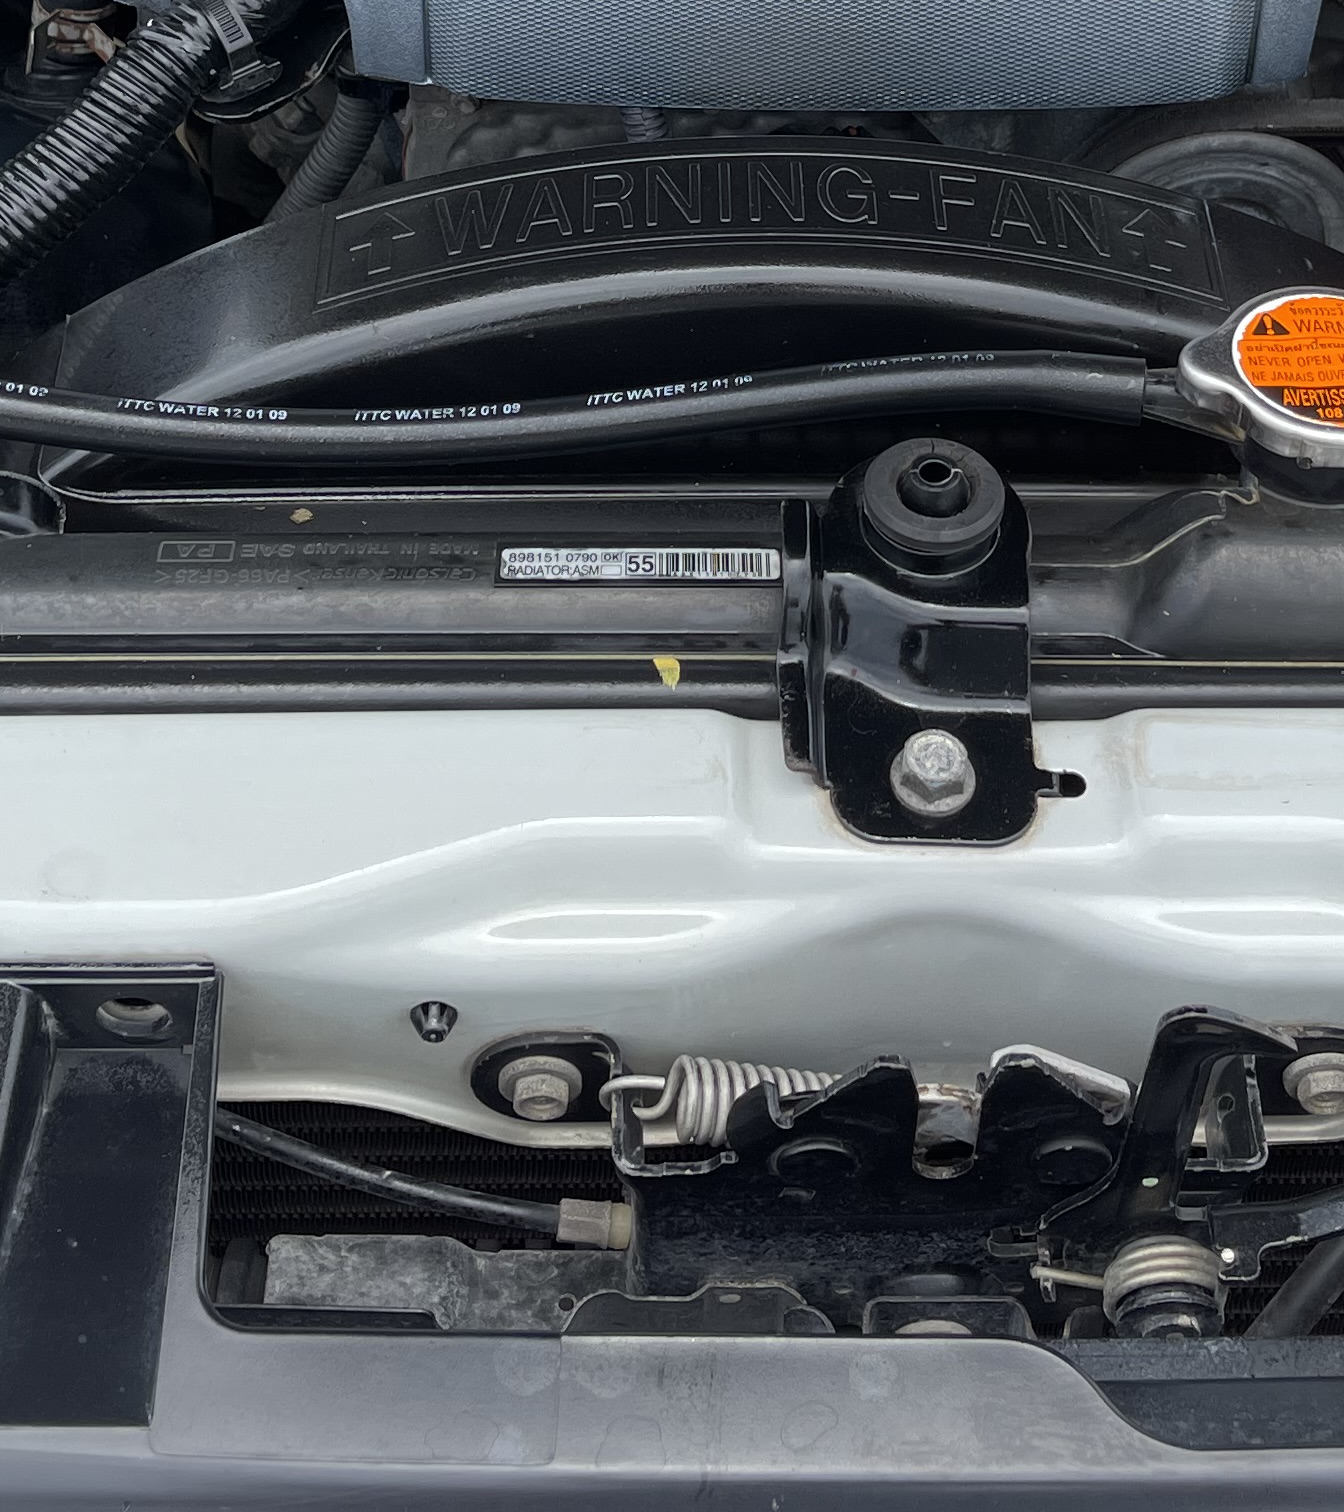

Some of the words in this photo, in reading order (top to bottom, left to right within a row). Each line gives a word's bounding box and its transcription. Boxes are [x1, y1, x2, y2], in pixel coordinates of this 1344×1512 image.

[432, 160, 1113, 262] WARNING-FAN
[1247, 354, 1291, 368] NEVER
[1296, 354, 1333, 368] OPEN
[1250, 369, 1267, 382] NE
[1270, 369, 1315, 383] JAMAIS
[5, 381, 27, 394] 01
[586, 391, 624, 406] ITTC
[625, 382, 686, 402] WATER
[689, 380, 708, 394] 12
[116, 397, 156, 412] ITTC
[158, 402, 220, 418] WATER
[223, 407, 244, 419] 12
[245, 408, 267, 420] 01
[268, 409, 288, 421] 09
[354, 408, 394, 423] ITTC
[394, 406, 456, 422] WATER
[458, 405, 478, 419] 12
[479, 404, 499, 417] 01
[501, 402, 522, 416] 09
[1315, 406, 1344, 420] 108
[302, 542, 392, 556] THAILAND
[508, 552, 561, 563] 898151
[565, 552, 599, 563] 0790
[602, 553, 620, 562] OK
[627, 554, 656, 574] 55
